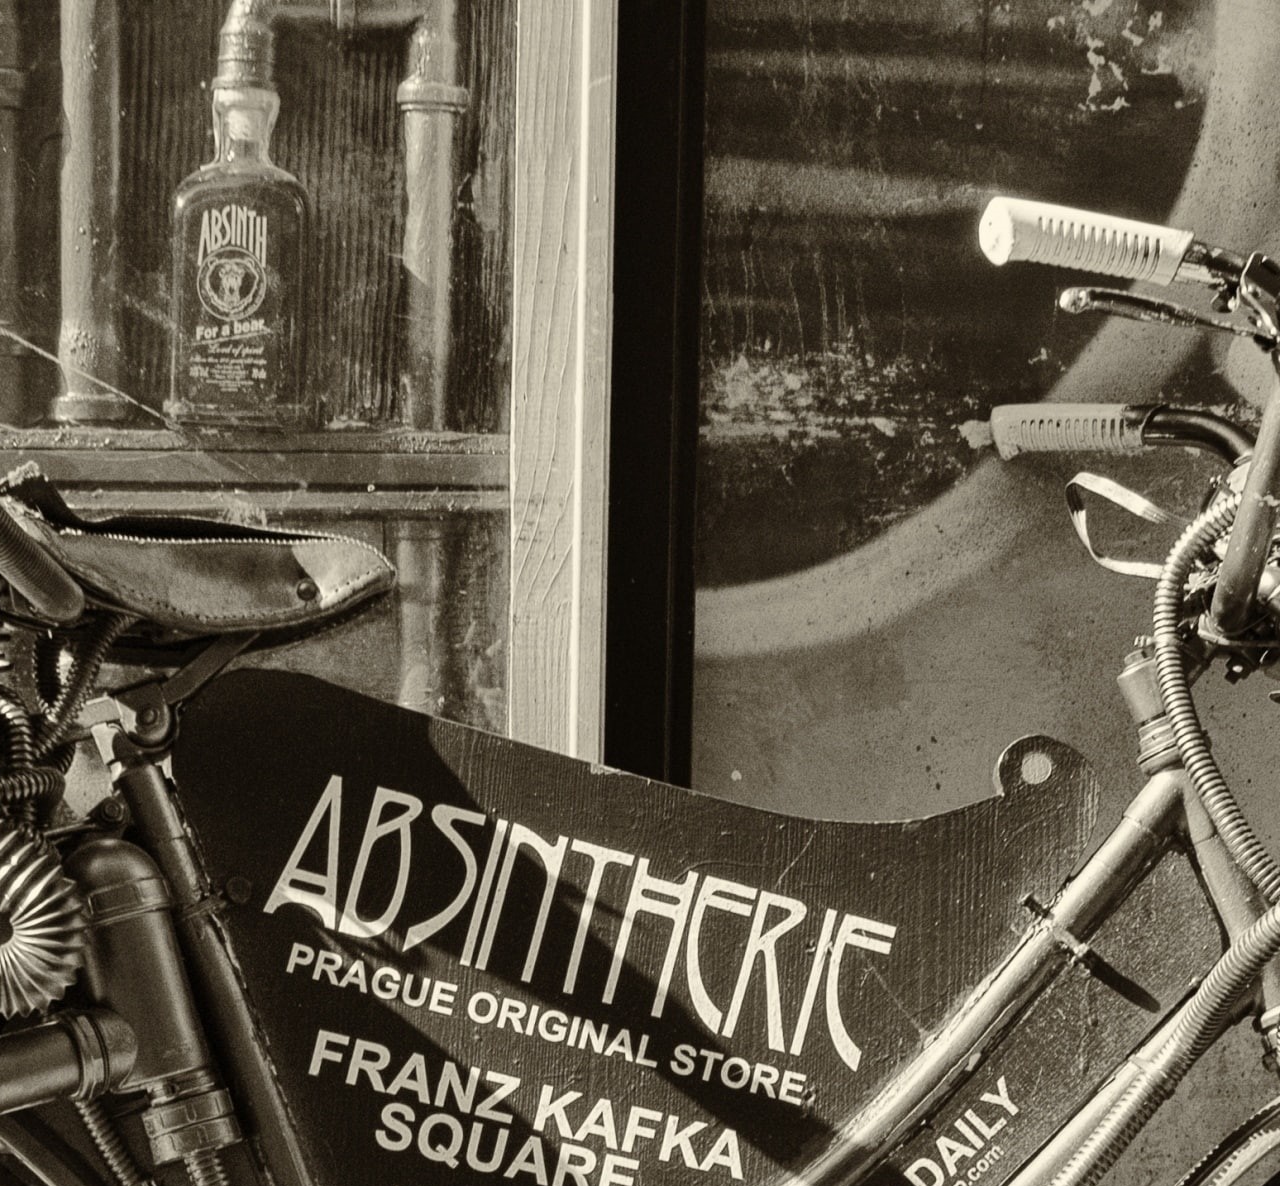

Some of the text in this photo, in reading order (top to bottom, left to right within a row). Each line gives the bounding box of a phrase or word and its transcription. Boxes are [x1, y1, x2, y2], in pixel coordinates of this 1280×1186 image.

[197, 203, 267, 268] ABSINTH
[195, 325, 218, 340] For
[221, 323, 230, 337] a
[263, 774, 897, 1072] ABSINTHERIE
[285, 942, 808, 1106] PRAGUE ORIGINAL STORE
[308, 1029, 744, 1181] FRANZ KAFKA
